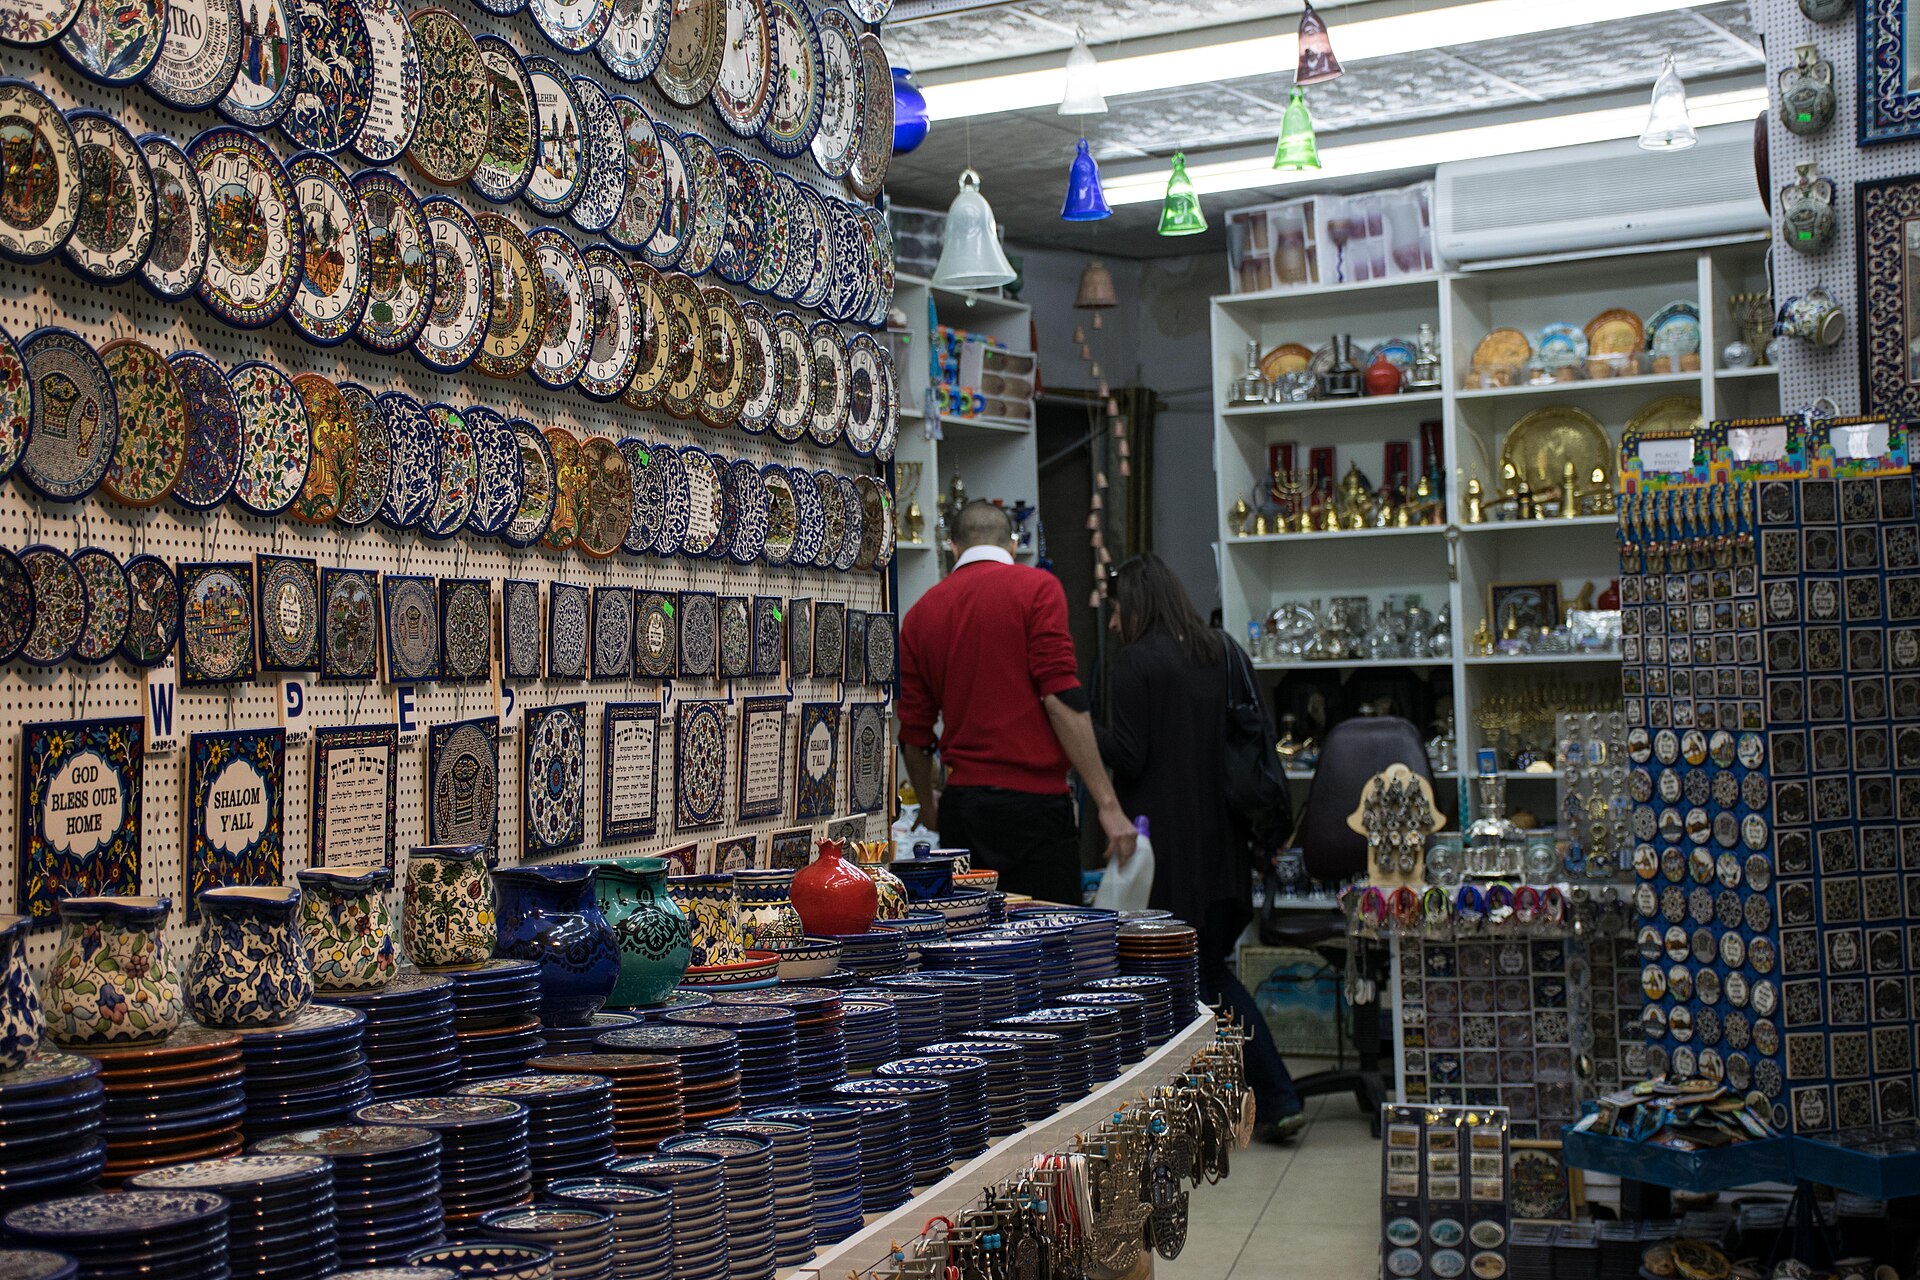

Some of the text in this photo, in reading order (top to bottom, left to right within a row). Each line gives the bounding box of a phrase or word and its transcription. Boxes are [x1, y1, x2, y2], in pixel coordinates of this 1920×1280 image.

[560, 11, 565, 25] 6
[578, 9, 583, 22] 5
[845, 65, 852, 80] 2
[846, 92, 854, 108] 3
[843, 118, 850, 134] 4
[81, 128, 93, 145] 12
[108, 132, 114, 147] 1
[126, 156, 135, 170] 2
[217, 160, 226, 180] 11
[234, 161, 249, 181] 12
[65, 173, 72, 188] ג
[136, 187, 145, 201] 3
[298, 186, 305, 204] 11
[312, 183, 323, 202] 12
[269, 204, 280, 222] 2
[137, 218, 146, 233] 4
[437, 223, 447, 240] 12
[272, 234, 283, 252] 3
[82, 249, 90, 264] 7
[127, 244, 135, 259] 5
[346, 247, 356, 264] 3
[106, 255, 114, 270] 6
[464, 252, 473, 268] 2
[211, 263, 221, 281] 7
[265, 263, 276, 280] 4
[230, 278, 241, 297] 6
[250, 278, 260, 296] 5
[342, 277, 352, 293] 4
[469, 278, 478, 294] 3
[299, 290, 307, 307] 7
[332, 295, 341, 313] 5
[315, 299, 324, 317] 6
[465, 306, 474, 321] 4
[711, 309, 719, 323] 12
[438, 330, 448, 346] 6
[454, 324, 463, 340] 5
[732, 327, 738, 340] 2
[735, 348, 742, 361] 3
[734, 371, 740, 383] 4
[717, 393, 724, 407] 6
[1730, 416, 1784, 427] JERUSALEM
[1833, 414, 1886, 425] JERUSALEM
[1642, 431, 1692, 440] JERUSALEM
[286, 682, 304, 718] פ
[149, 683, 174, 736] W
[397, 686, 417, 732] E
[617, 727, 652, 745] ברכת הבית
[810, 739, 829, 752] SHALOM
[331, 756, 385, 781] ברכת הבית
[812, 754, 826, 767] Y'ALL
[71, 765, 99, 784] GOD
[51, 787, 118, 812] BLESS OUR
[213, 787, 261, 809] SHALOM
[66, 814, 102, 835] HOME
[221, 812, 254, 832] Y'ALL
[670, 866, 682, 876] LOM
